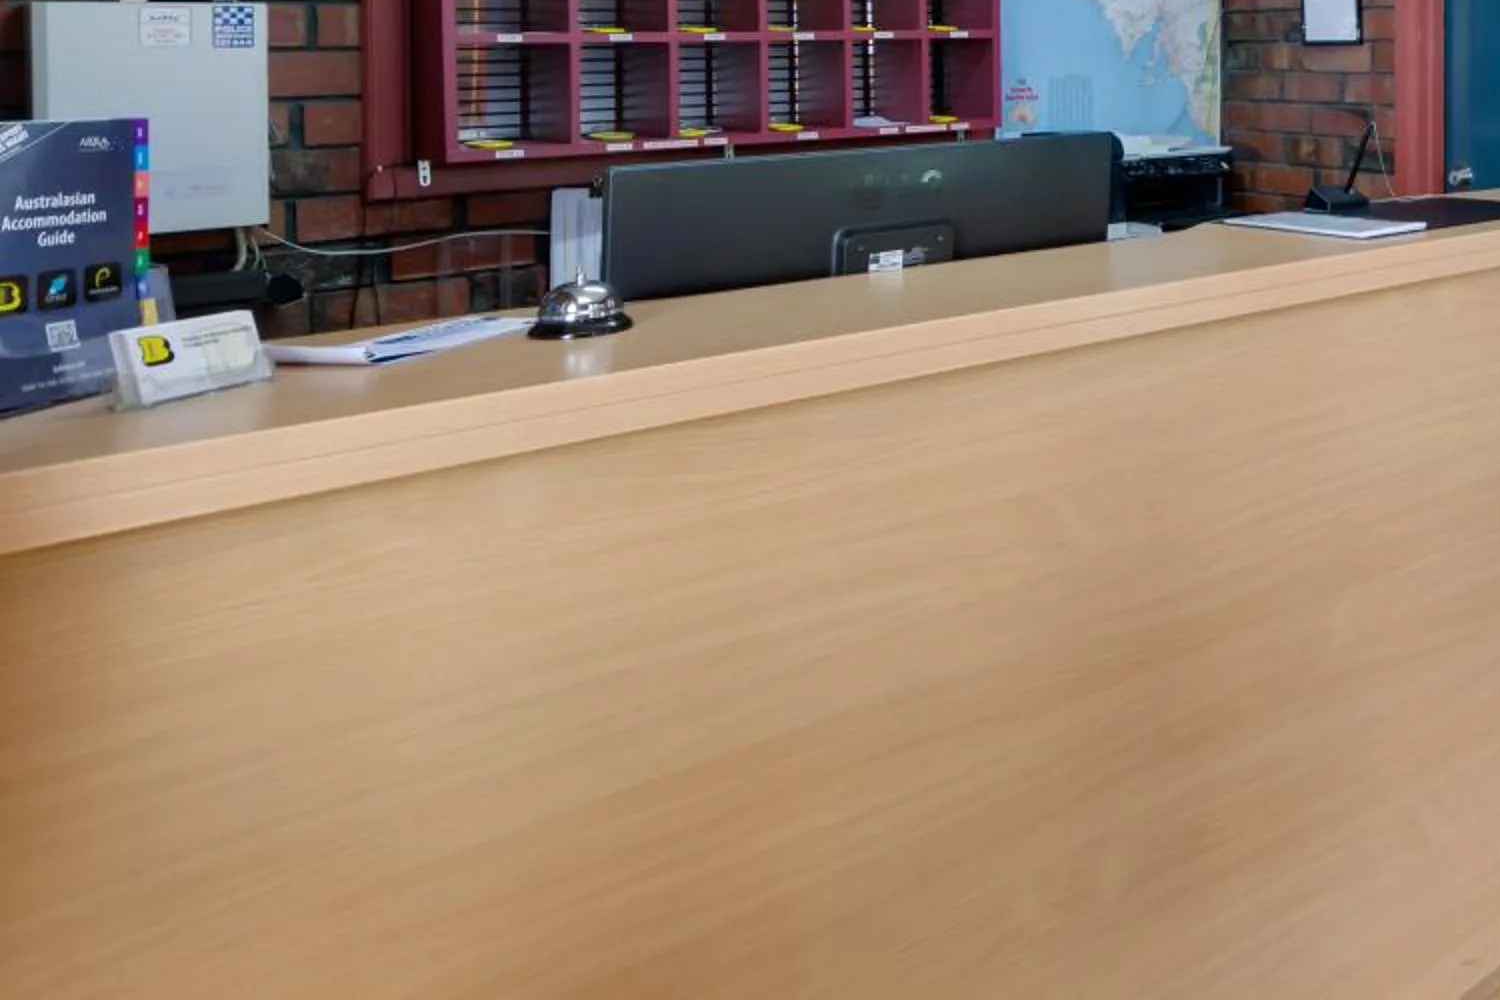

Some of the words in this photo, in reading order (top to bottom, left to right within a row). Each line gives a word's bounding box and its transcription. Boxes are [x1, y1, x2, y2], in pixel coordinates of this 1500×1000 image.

[14, 191, 96, 211] Australasian
[1, 208, 107, 232] Accommodation
[37, 228, 76, 248] Guide
